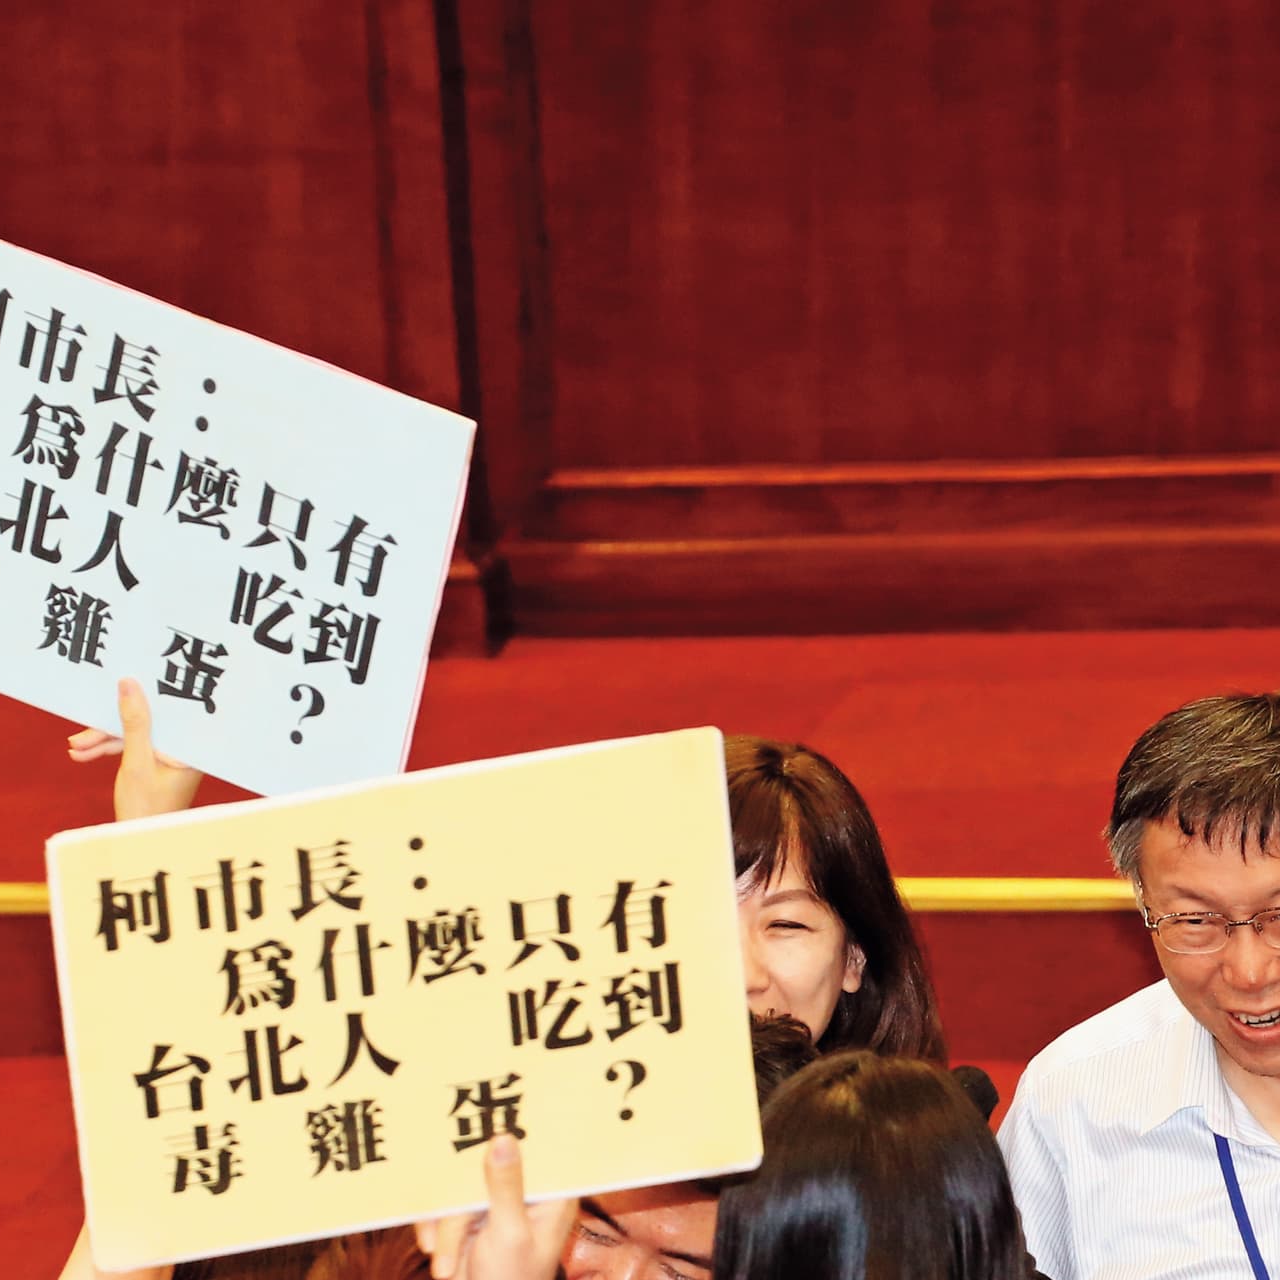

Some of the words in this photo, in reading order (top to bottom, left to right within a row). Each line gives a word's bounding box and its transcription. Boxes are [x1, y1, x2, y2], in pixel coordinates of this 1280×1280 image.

[229, 565, 382, 686] 吃到
[94, 834, 432, 953] 柯市長：
[133, 1010, 402, 1120] 台北人
[505, 960, 684, 1052] 吃到
